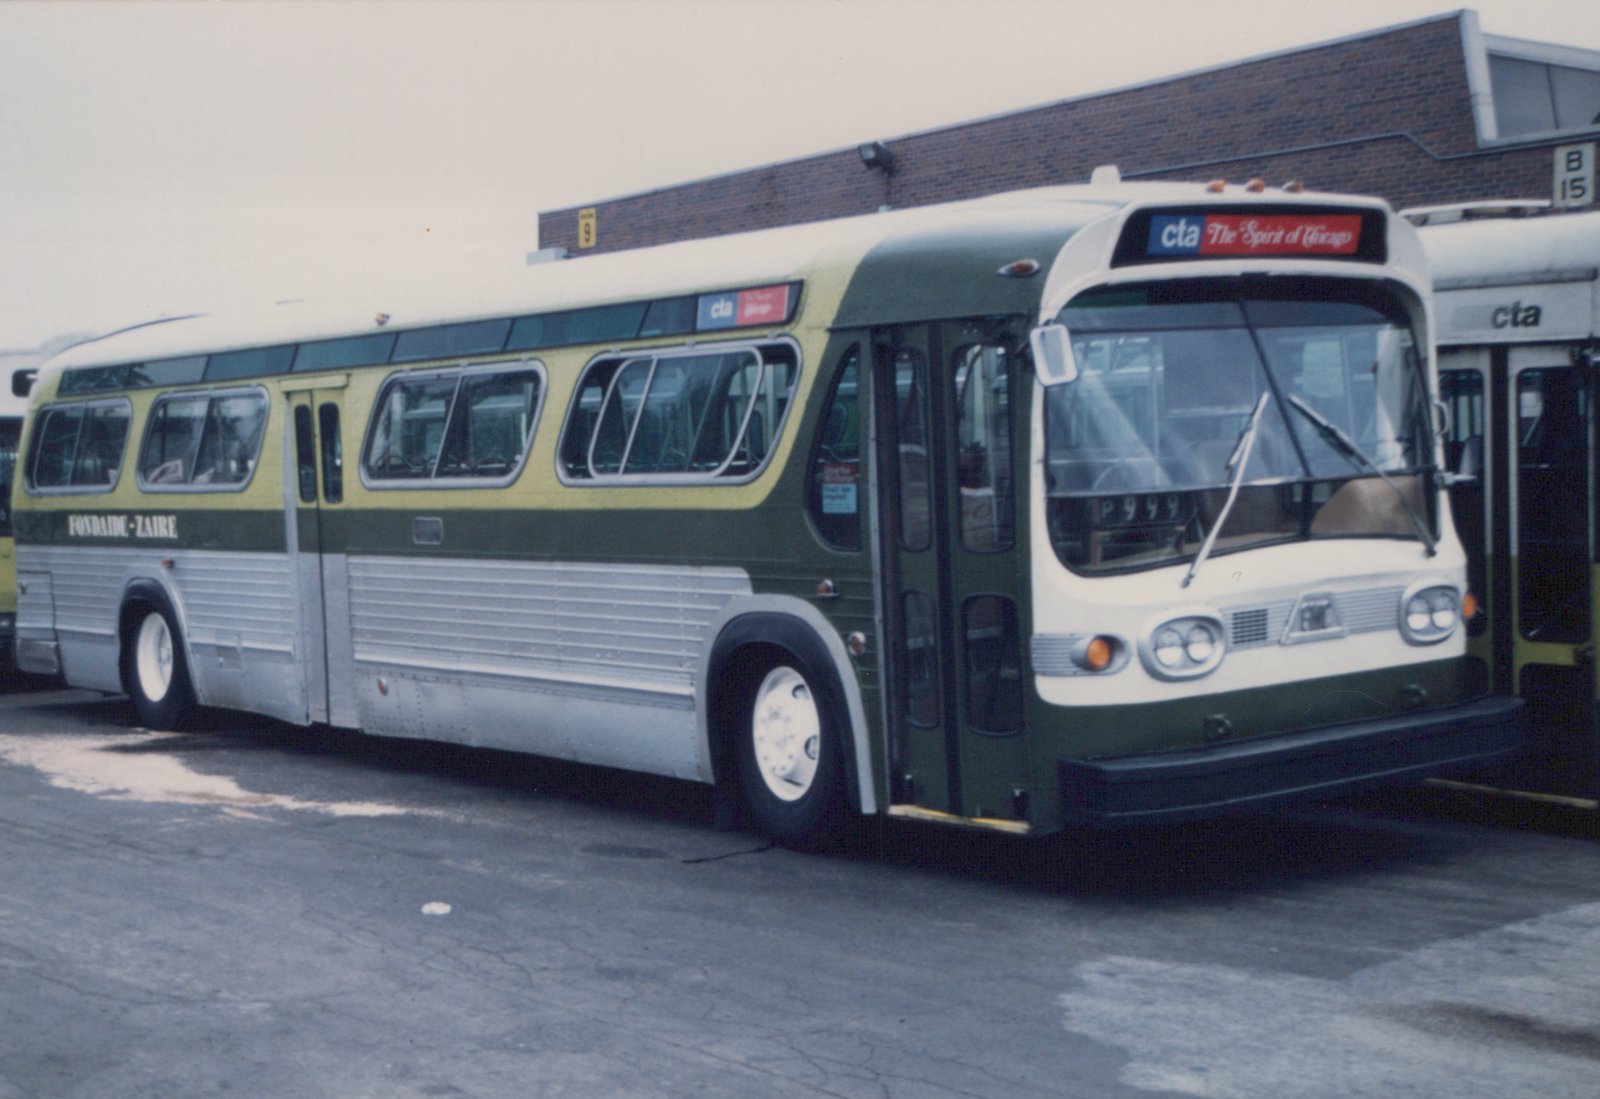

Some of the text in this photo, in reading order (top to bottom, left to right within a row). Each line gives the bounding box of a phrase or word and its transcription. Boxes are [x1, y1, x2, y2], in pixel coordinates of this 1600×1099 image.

[1566, 151, 1582, 172] B
[1561, 177, 1586, 200] 15
[584, 222, 591, 243] 9
[1161, 218, 1353, 249] cta The Spirit of Chicago
[1491, 302, 1541, 328] cta
